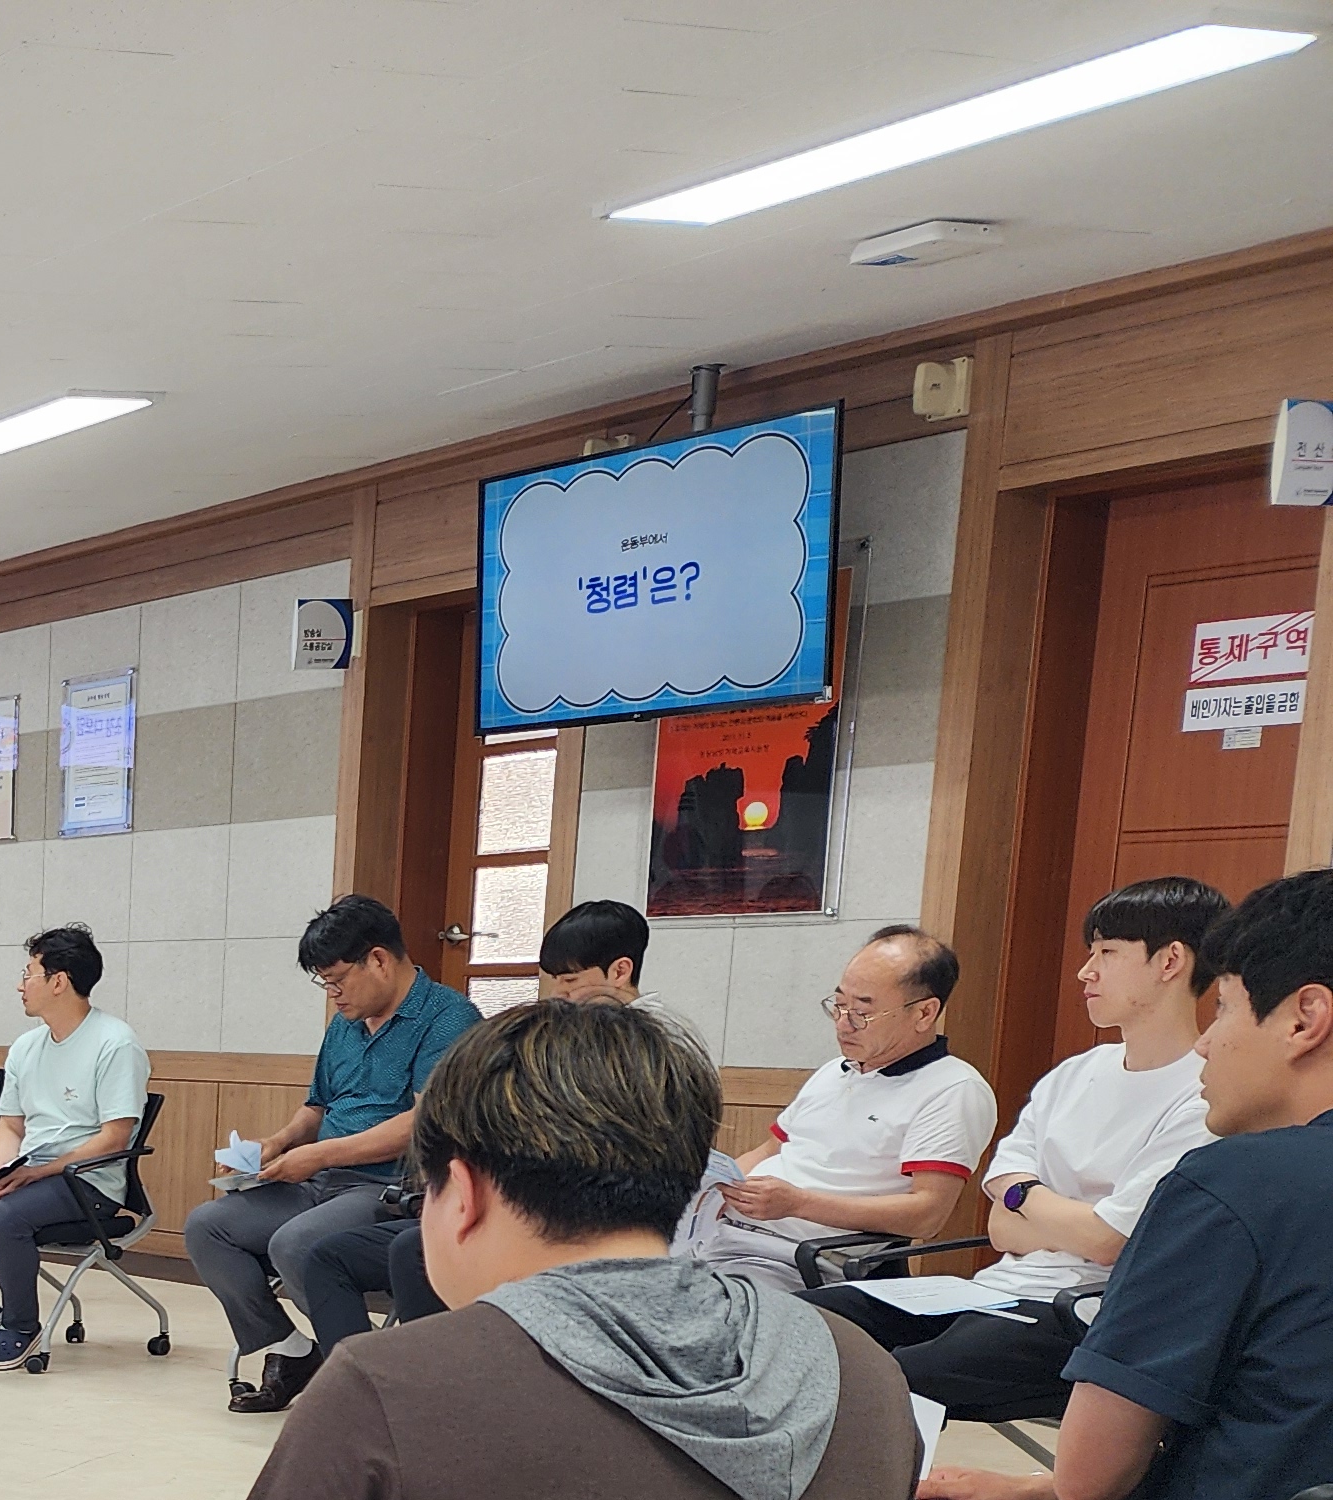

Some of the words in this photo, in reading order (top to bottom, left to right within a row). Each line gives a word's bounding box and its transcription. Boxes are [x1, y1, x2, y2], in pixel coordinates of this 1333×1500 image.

[620, 532, 669, 552] 운동부에서
[578, 561, 701, 614] '청렴'은?
[1197, 627, 1309, 666] 통제구역
[1190, 697, 1242, 719] 비인가자는
[1244, 693, 1276, 716] 출입을
[1277, 691, 1300, 713] 금함
